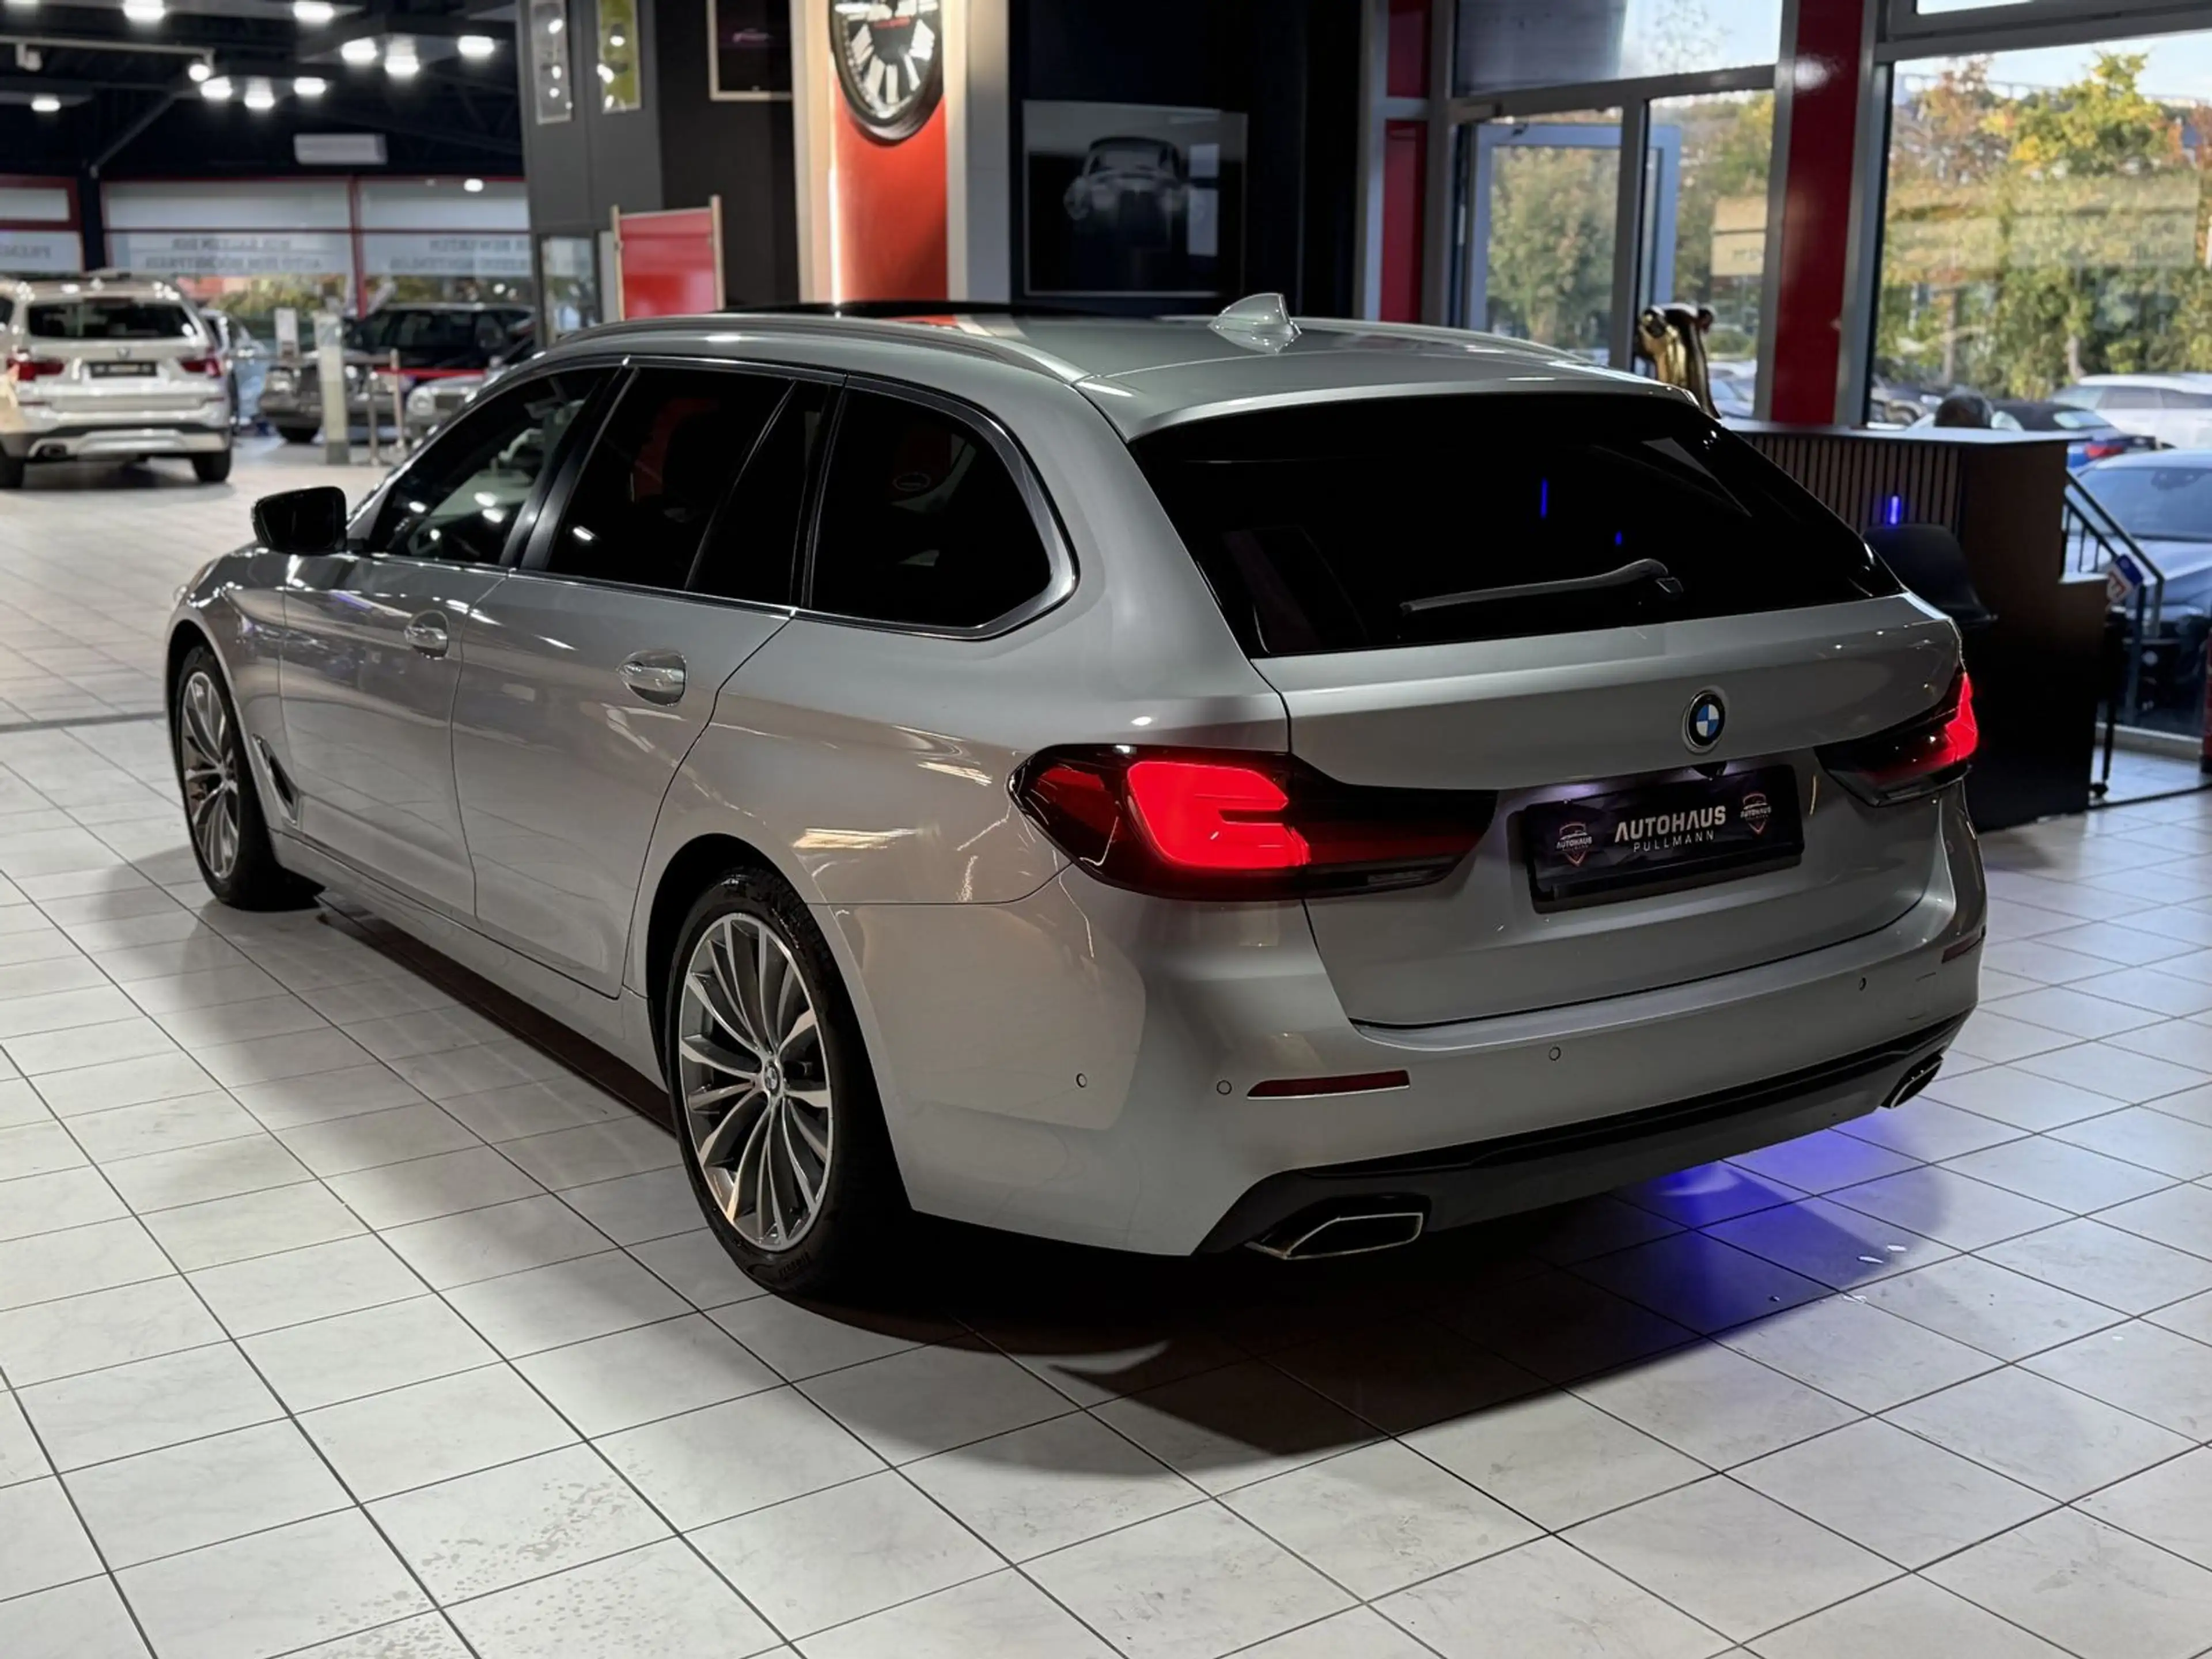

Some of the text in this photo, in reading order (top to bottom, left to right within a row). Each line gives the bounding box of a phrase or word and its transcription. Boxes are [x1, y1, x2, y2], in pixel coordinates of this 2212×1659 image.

[1615, 805, 1726, 843] AUTOHAUS
[1556, 836, 1592, 849] AUTOHAUS
[1634, 830, 1714, 853] PULLMANN
